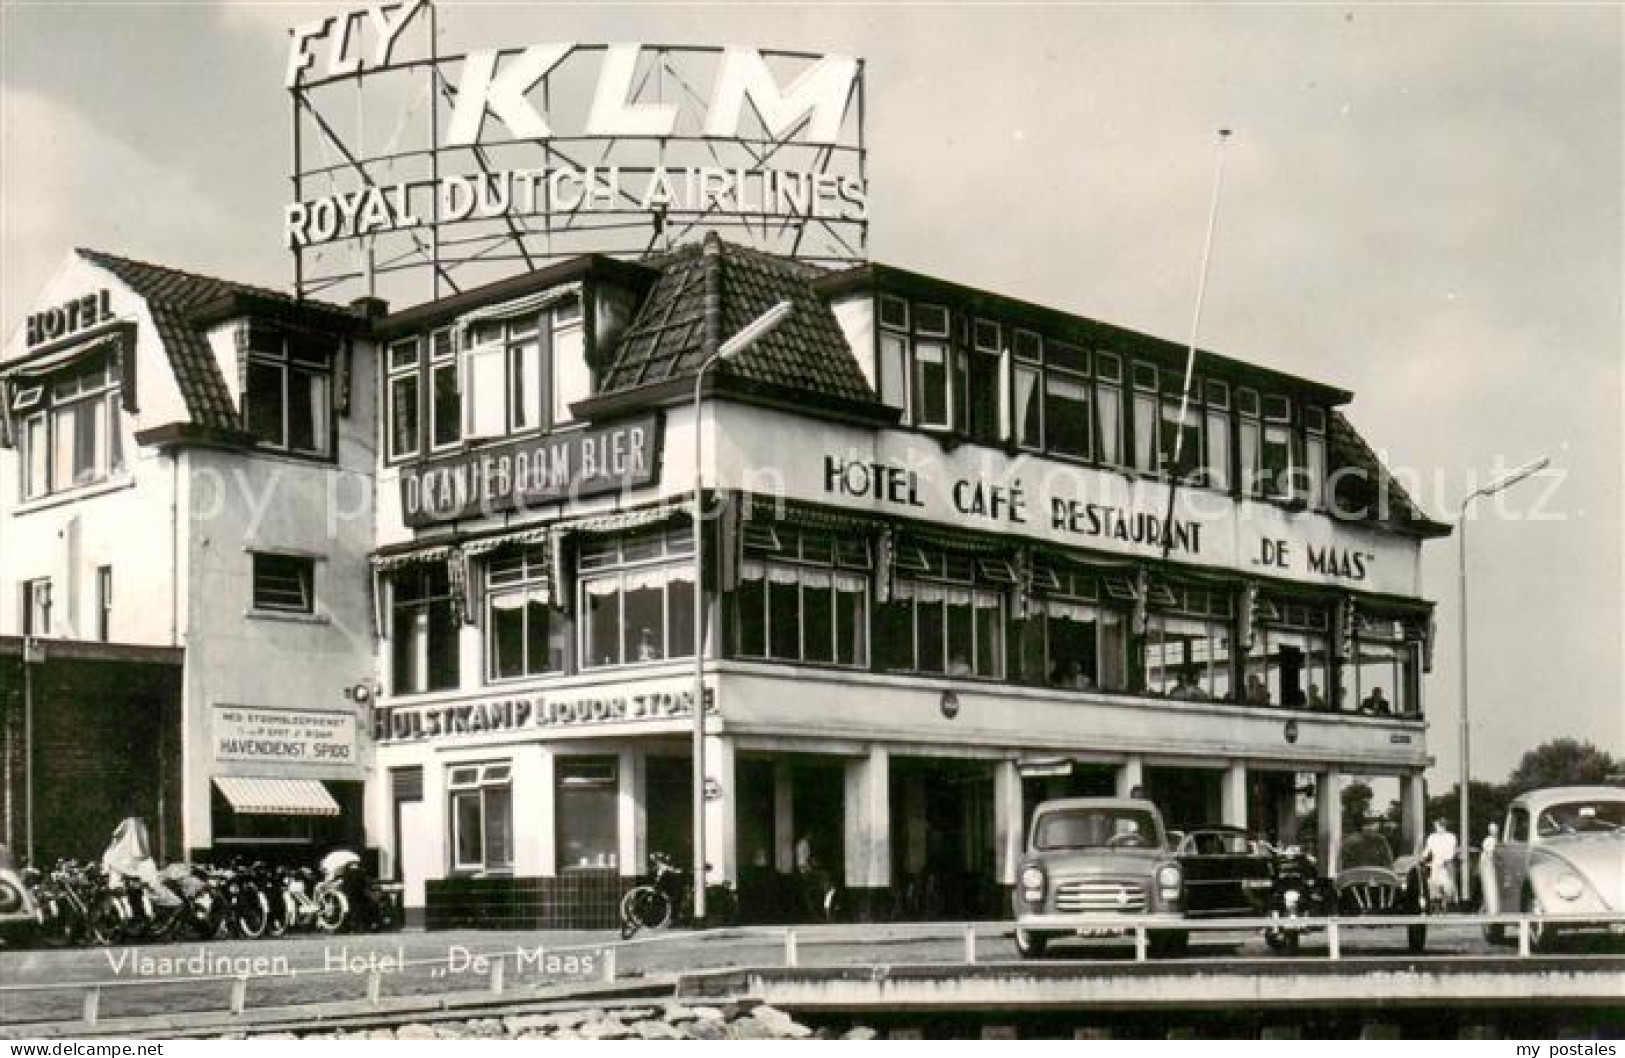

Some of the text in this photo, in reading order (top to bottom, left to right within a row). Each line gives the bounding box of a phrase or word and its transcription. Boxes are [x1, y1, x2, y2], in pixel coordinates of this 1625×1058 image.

[285, 0, 424, 88] FLY
[446, 43, 861, 147] KLM
[284, 166, 869, 247] ROYAL DUTCH AIRLINES
[27, 287, 116, 348] HOTEL
[407, 427, 644, 515] ORANJEBOOM BIER
[823, 454, 924, 507] HOTEL
[952, 478, 1027, 524] CAFÉ
[1051, 496, 1202, 555] RESTAURANT
[372, 699, 532, 742] HULSTKAMP
